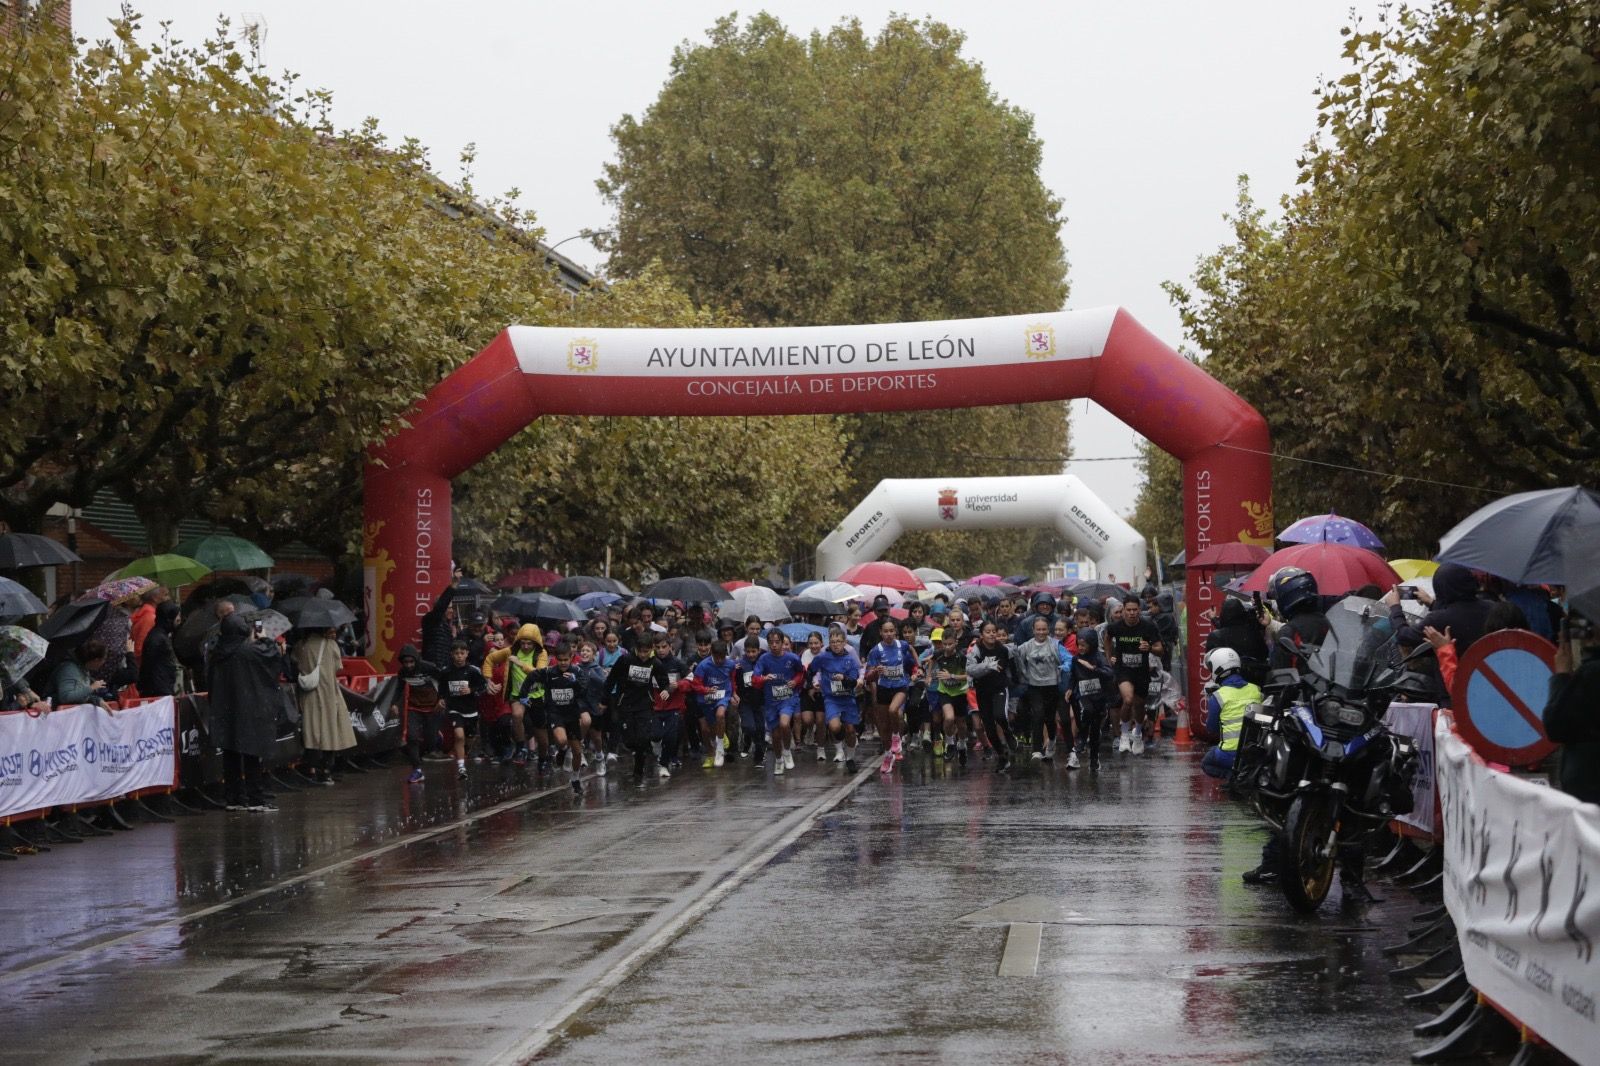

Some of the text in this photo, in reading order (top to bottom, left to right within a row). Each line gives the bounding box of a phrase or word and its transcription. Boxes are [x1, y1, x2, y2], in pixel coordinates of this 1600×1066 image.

[647, 335, 975, 368] AYUNTAMIENTO DE LEÓN
[687, 374, 937, 397] CONCEJALÍA DE DEPORTES
[965, 492, 1017, 503] universidad
[1197, 470, 1211, 552] EPORTES
[416, 488, 432, 584] DEPORTES
[846, 511, 883, 548] DEPORTES
[1071, 505, 1110, 542] DEPORTES
[416, 592, 430, 616] DE
